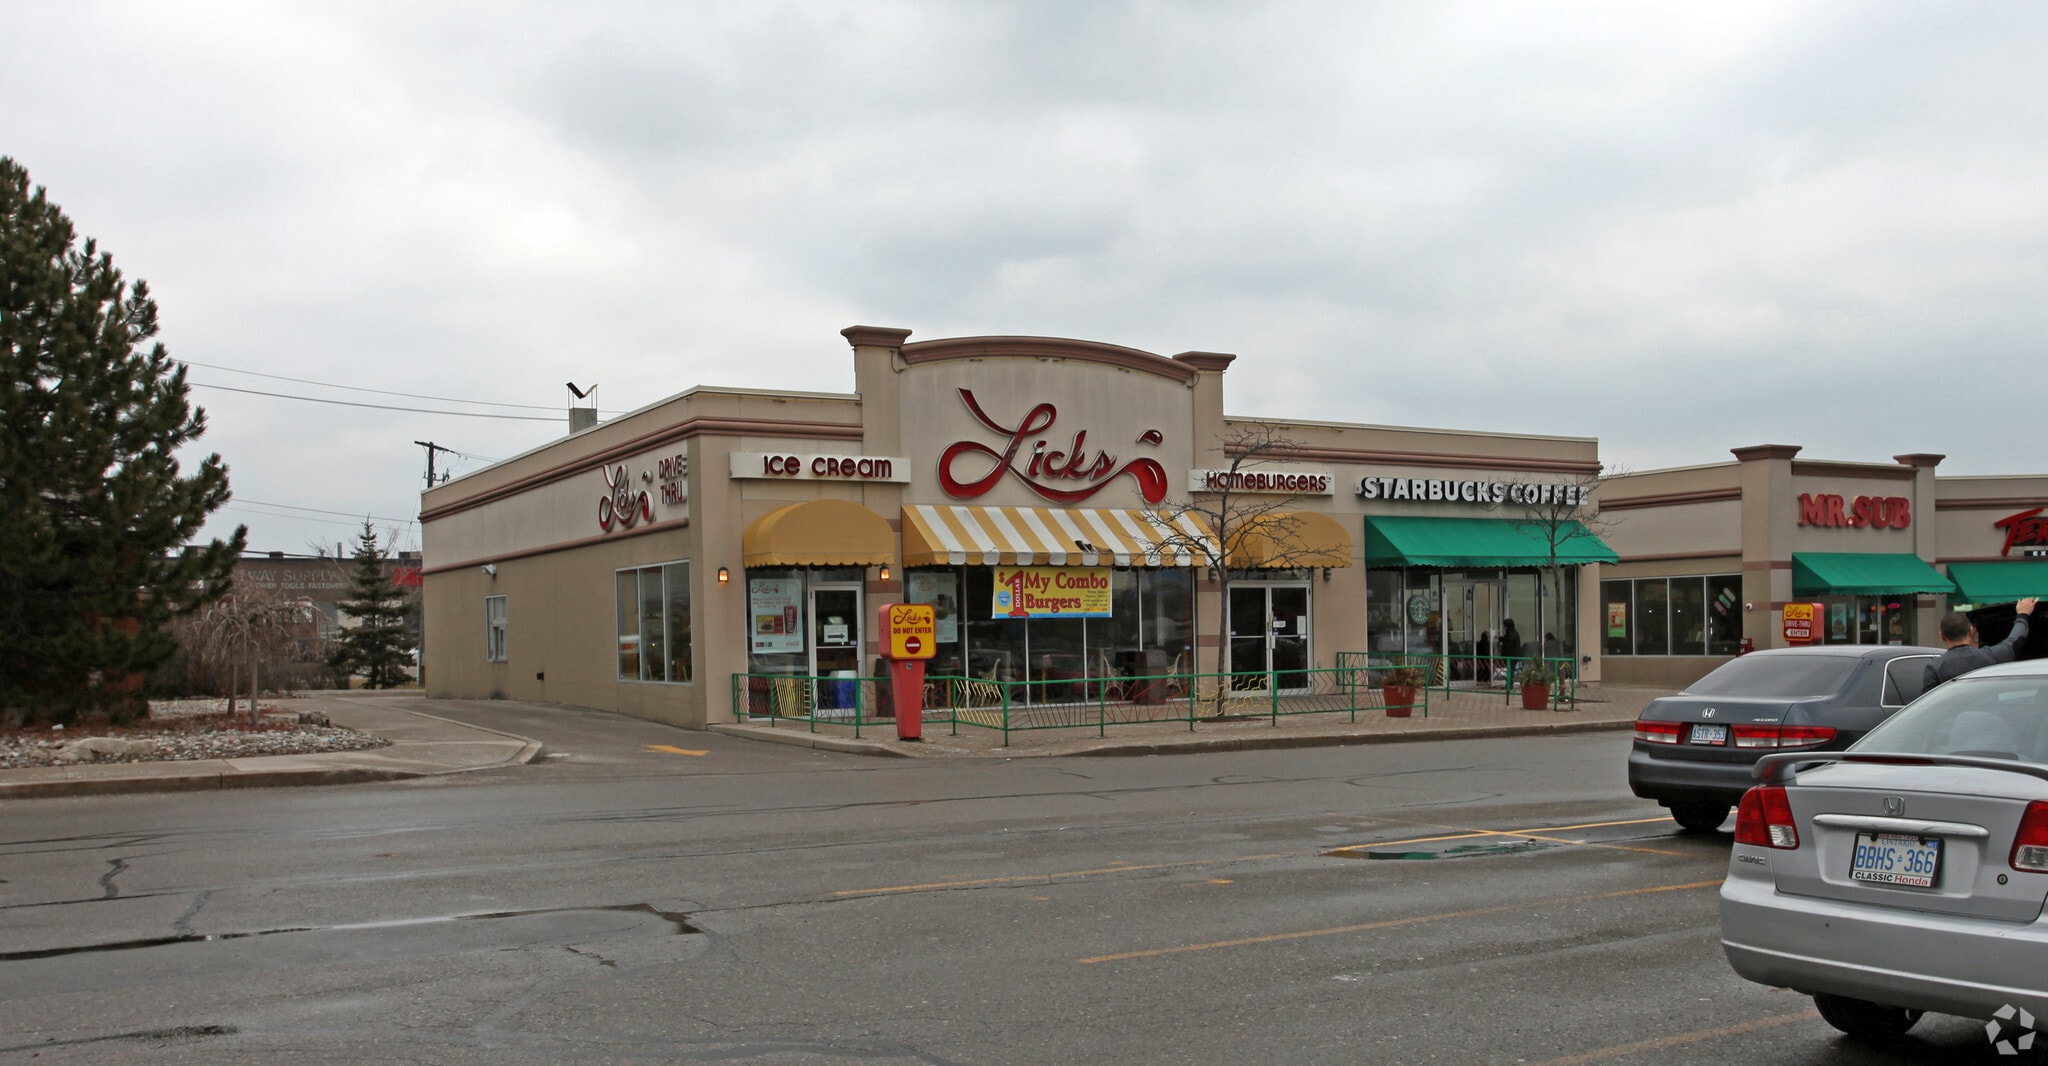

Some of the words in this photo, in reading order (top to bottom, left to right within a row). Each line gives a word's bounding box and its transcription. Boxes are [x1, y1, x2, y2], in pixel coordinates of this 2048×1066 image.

[660, 480, 684, 505] THRU
[1362, 477, 1504, 503] STARBUCKS
[1510, 484, 1589, 506] COFFEE
[1024, 572, 1050, 594] My
[1055, 571, 1108, 589] Combo
[1025, 593, 1081, 613] Burgers
[1881, 839, 1916, 848] ONTARIO
[1855, 845, 1896, 871] BBHS
[1904, 849, 1935, 874] 366
[1855, 871, 1893, 882] CLASSIC
[1894, 874, 1929, 886] Honda
